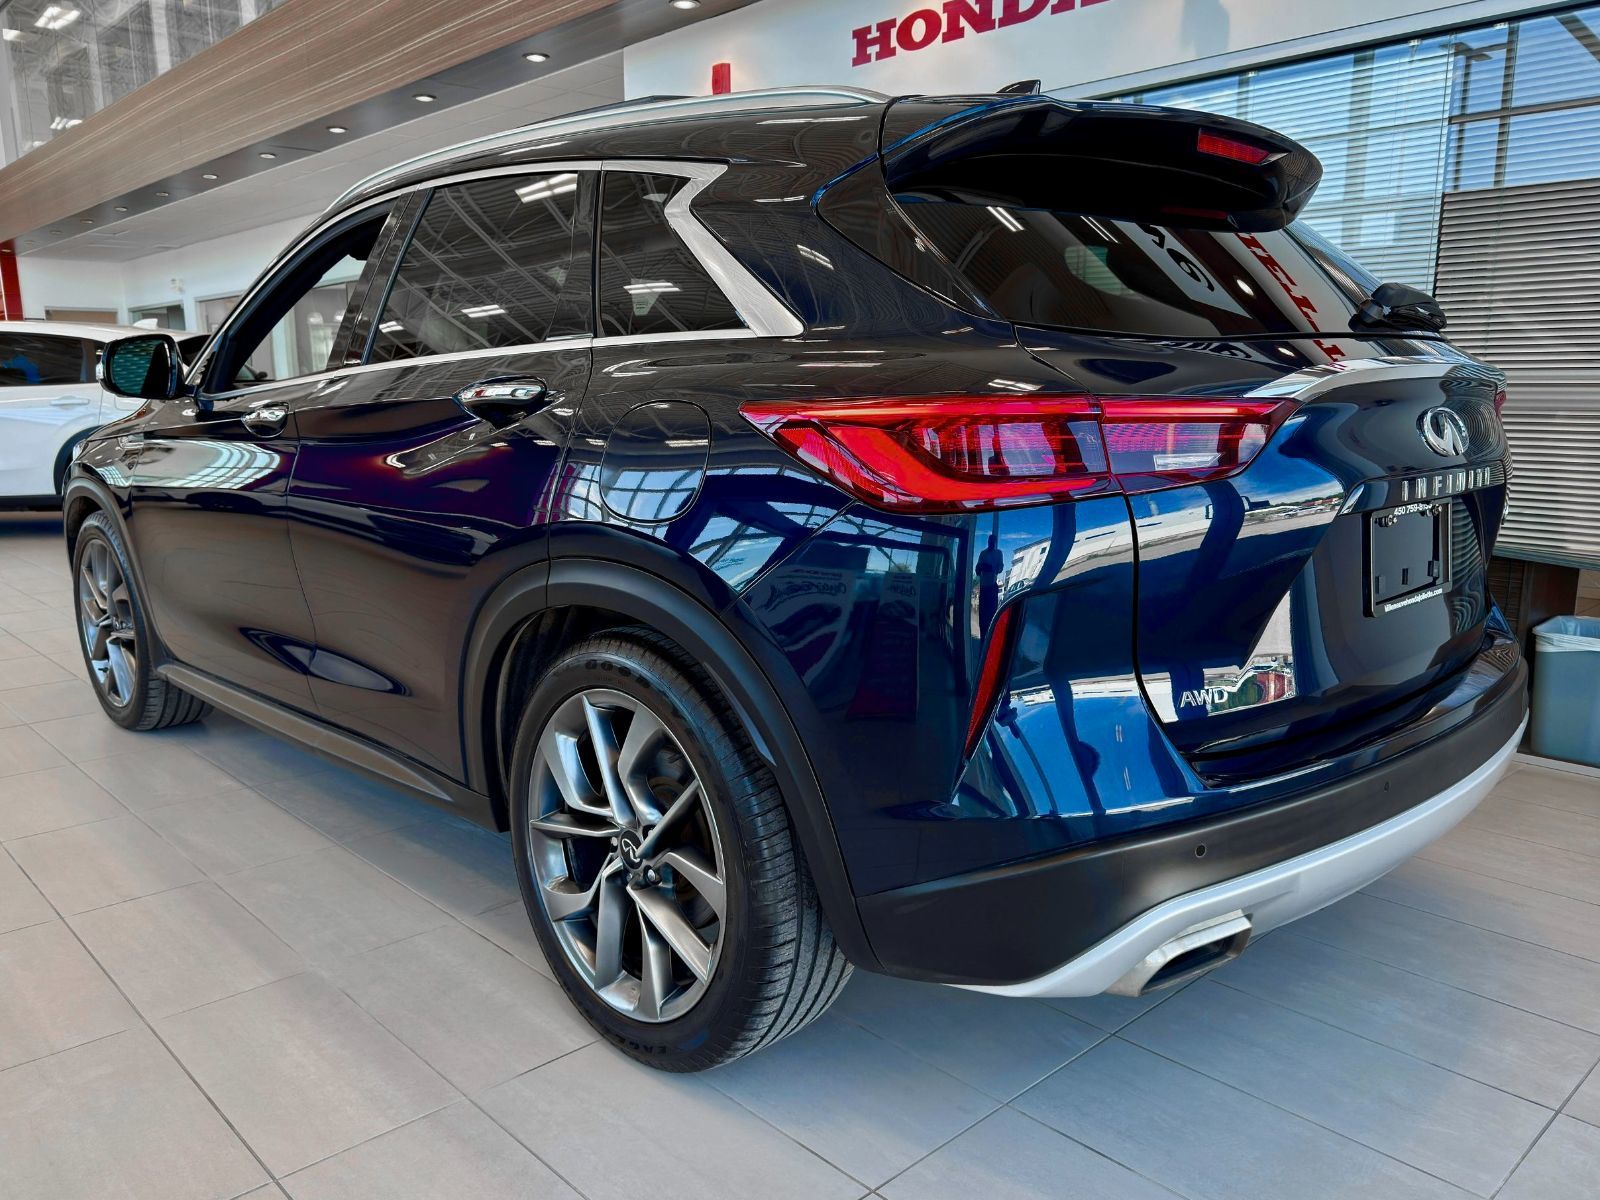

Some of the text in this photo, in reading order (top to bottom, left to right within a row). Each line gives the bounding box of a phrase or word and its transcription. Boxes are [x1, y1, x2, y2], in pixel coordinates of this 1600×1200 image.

[852, 0, 1110, 67] HOND
[1401, 466, 1491, 502] INFINITI
[1393, 505, 1406, 516] 450
[1178, 688, 1229, 708] AWD
